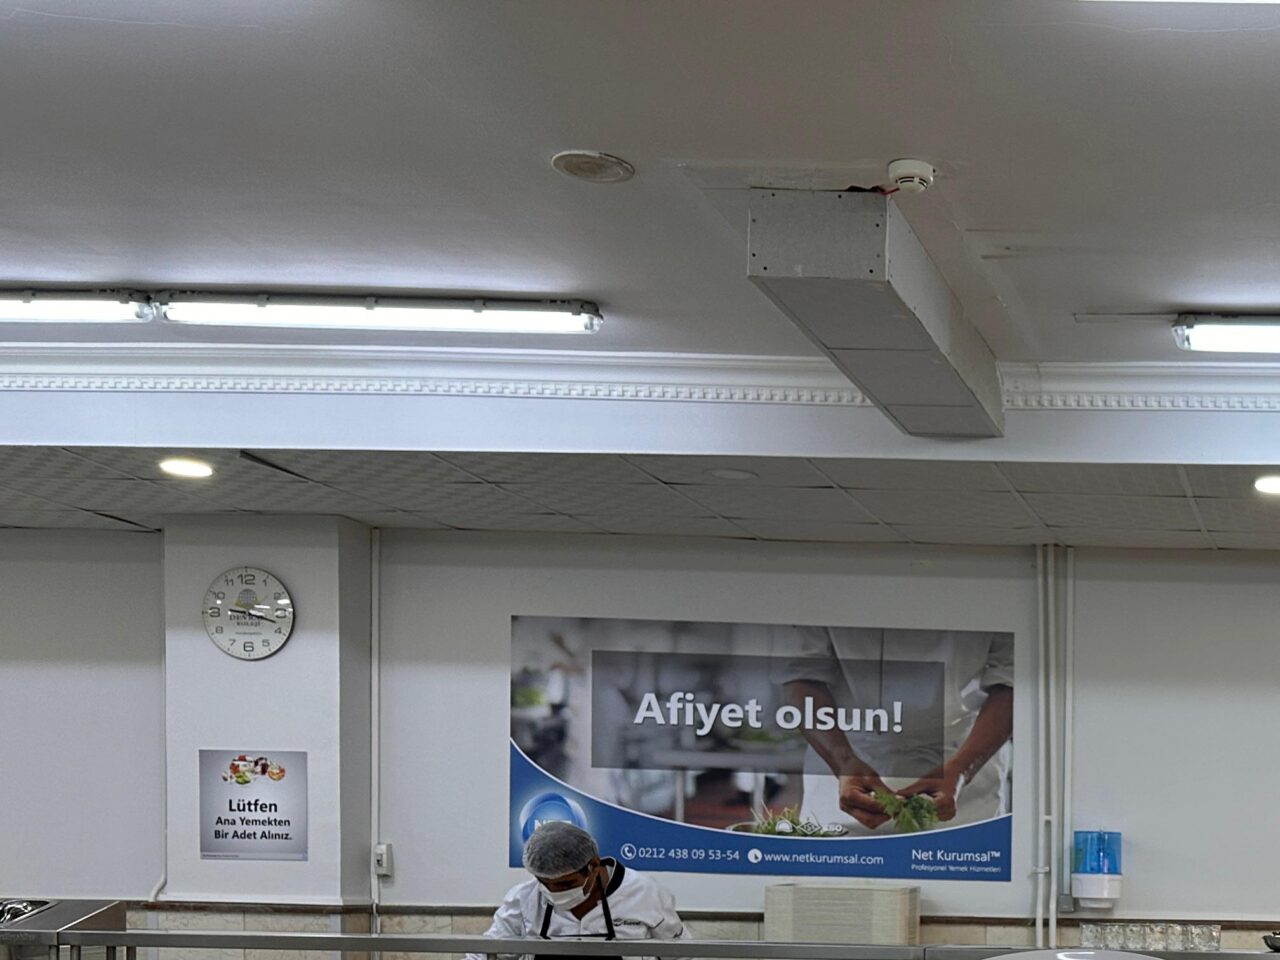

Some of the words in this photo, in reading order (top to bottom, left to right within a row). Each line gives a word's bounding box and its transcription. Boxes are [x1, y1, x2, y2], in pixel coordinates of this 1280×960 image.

[237, 574, 255, 585] 12
[262, 579, 267, 587] 1
[216, 626, 223, 634] 8
[243, 641, 254, 652] 6
[262, 639, 270, 647] 5
[633, 691, 762, 736] Afiyet
[775, 695, 903, 734] olsun!
[228, 798, 278, 813] Lütfen
[215, 816, 237, 826] Ana
[239, 816, 291, 827] Yemekten
[214, 829, 230, 840] Bir
[231, 829, 257, 840] Adet
[260, 829, 293, 841] Alınız.
[638, 847, 665, 859] 0212
[668, 848, 689, 860] 438
[691, 849, 705, 860] 09
[708, 849, 740, 861] 53-54
[764, 852, 884, 865] www.netkurumsal.com
[911, 849, 933, 861] Net
